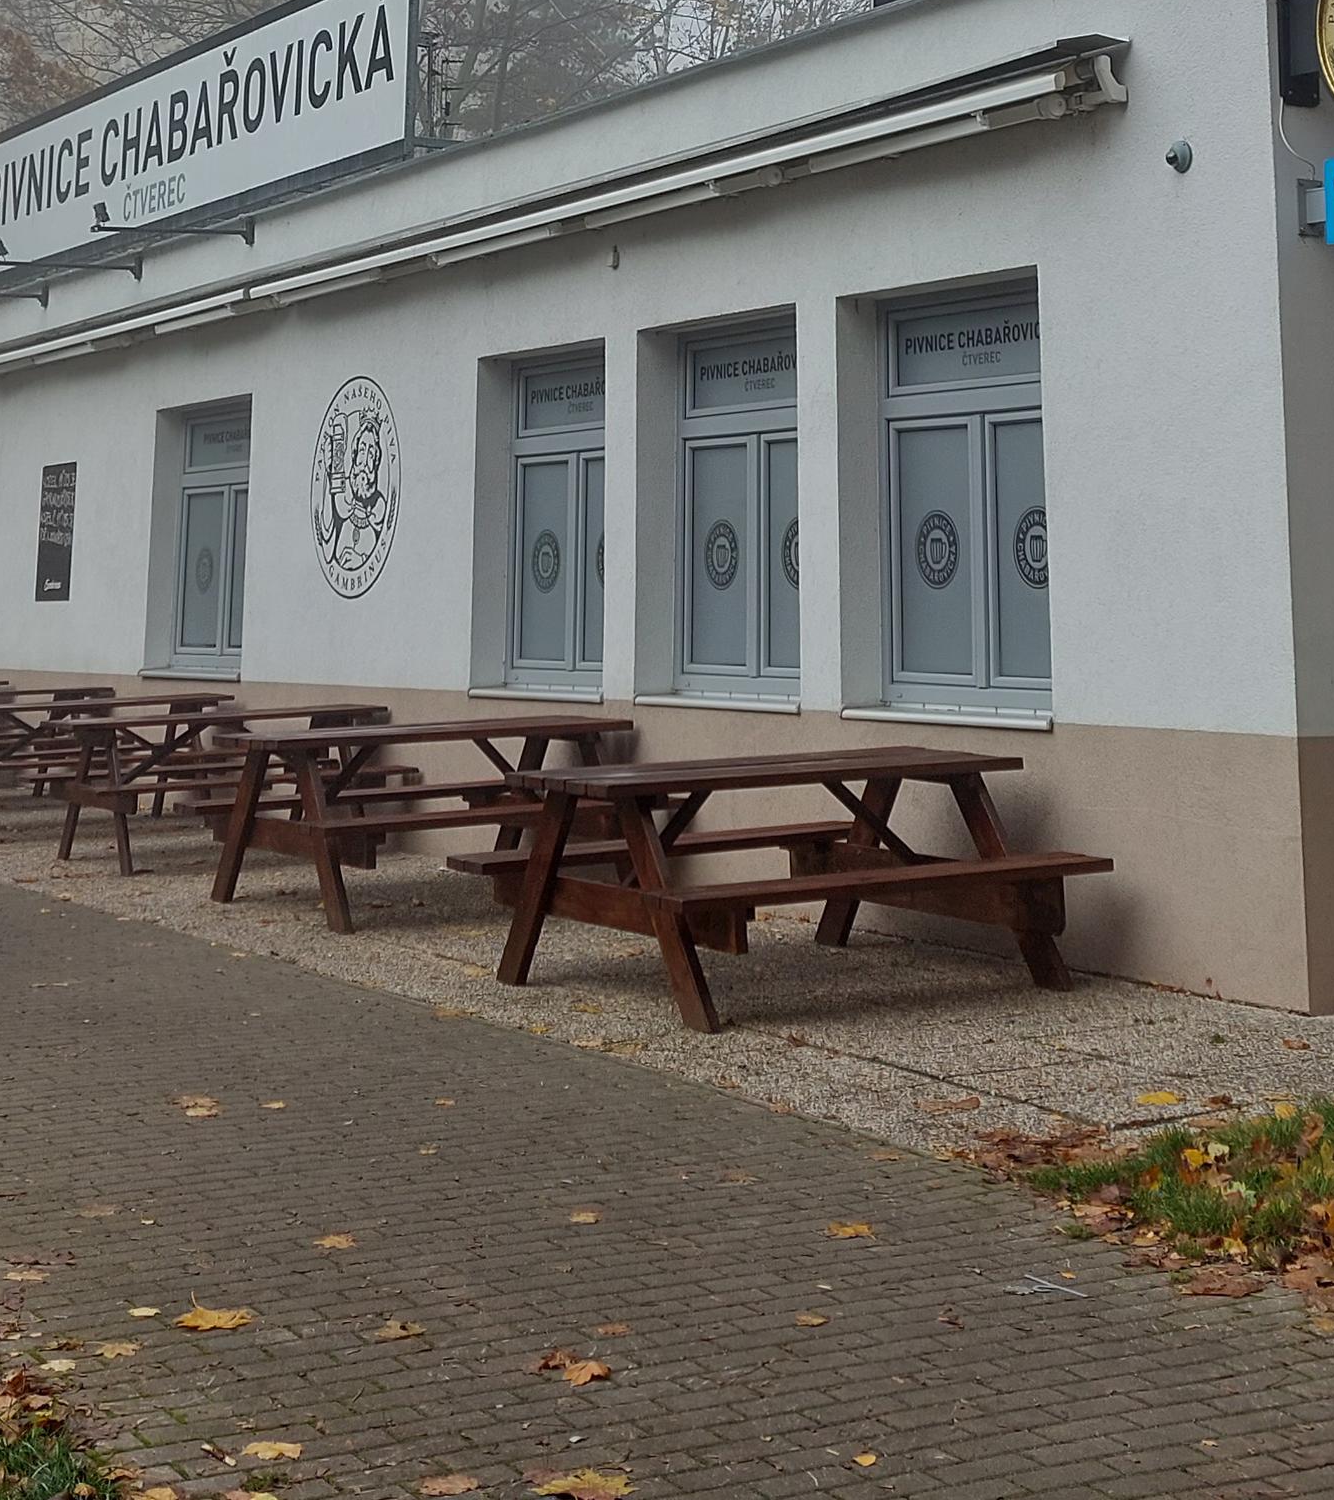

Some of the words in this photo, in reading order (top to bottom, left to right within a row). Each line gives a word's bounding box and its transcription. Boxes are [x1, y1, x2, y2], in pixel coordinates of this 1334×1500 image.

[122, 172, 187, 222] ČTVEREC
[905, 332, 955, 355] PIVNICE
[700, 361, 740, 381] PIVNICE
[328, 538, 387, 591] GAMBRINUS
